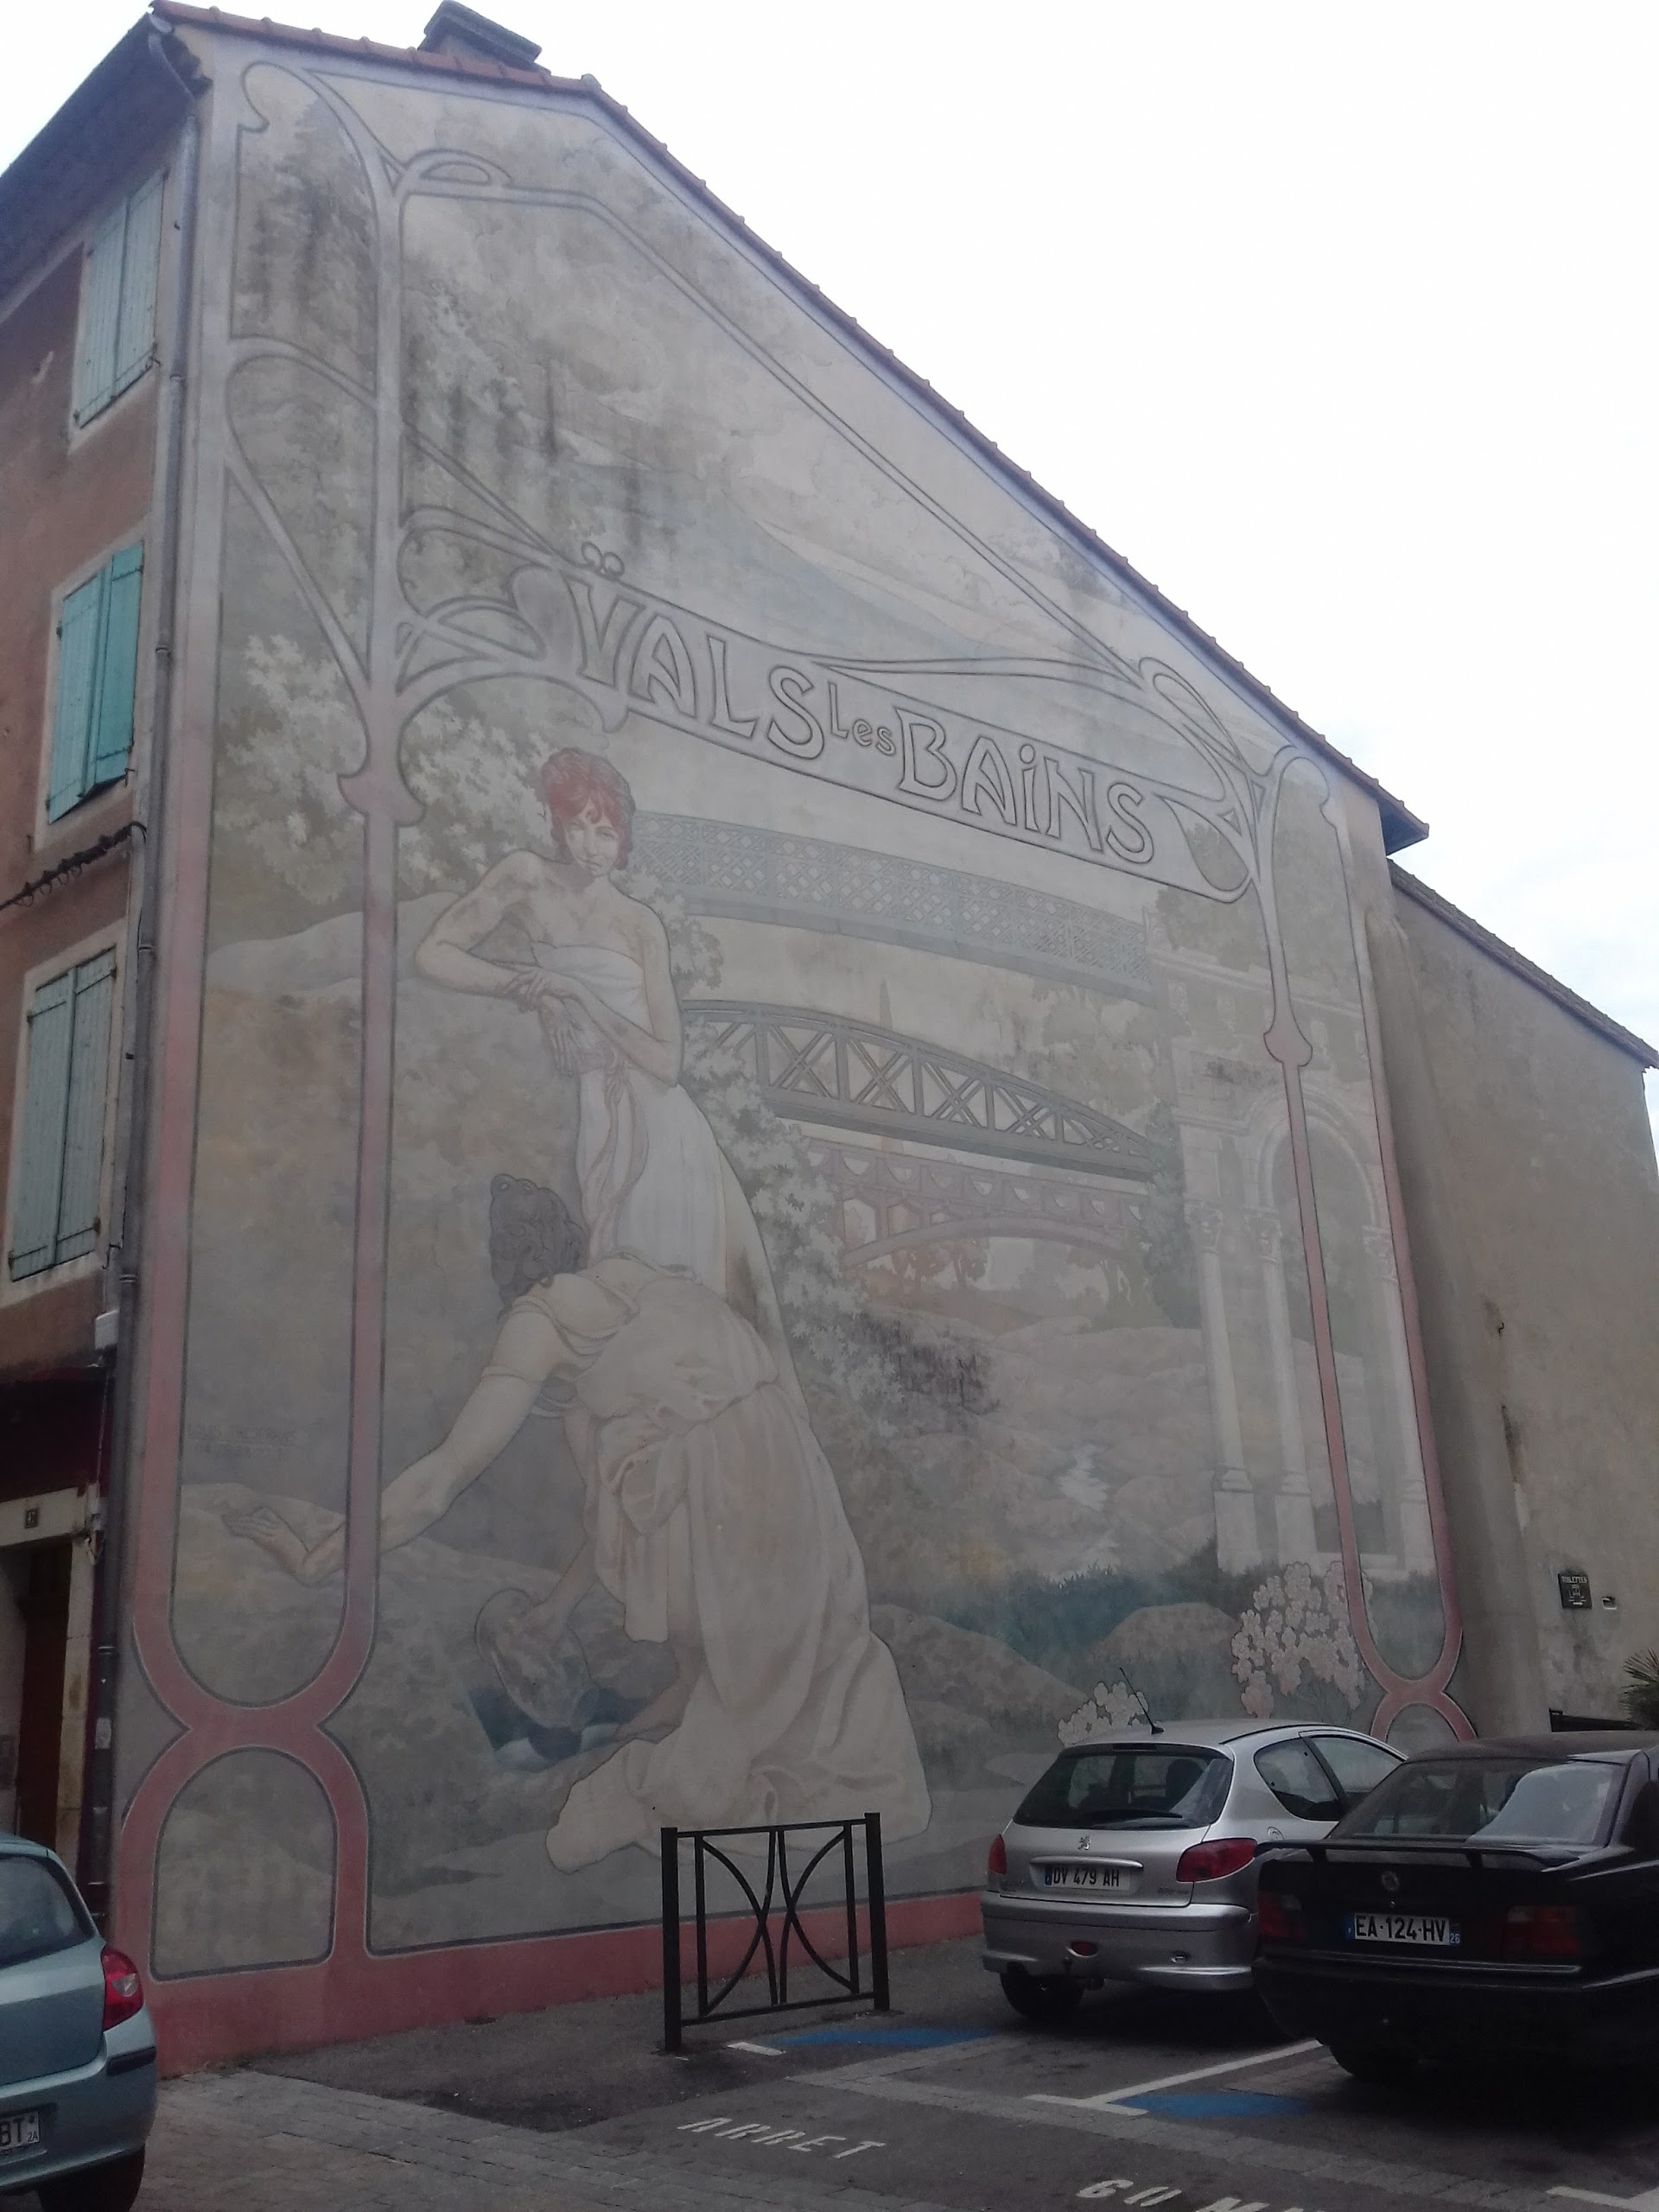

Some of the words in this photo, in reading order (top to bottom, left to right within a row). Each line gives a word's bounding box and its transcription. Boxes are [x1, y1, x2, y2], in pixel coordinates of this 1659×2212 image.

[561, 575, 824, 760] VALS
[827, 681, 897, 757] Les
[1053, 1866, 1068, 1884] DV
[1073, 1867, 1097, 1885] 479
[1103, 1869, 1120, 1887] AH
[1075, 2179, 1182, 2207] 60
